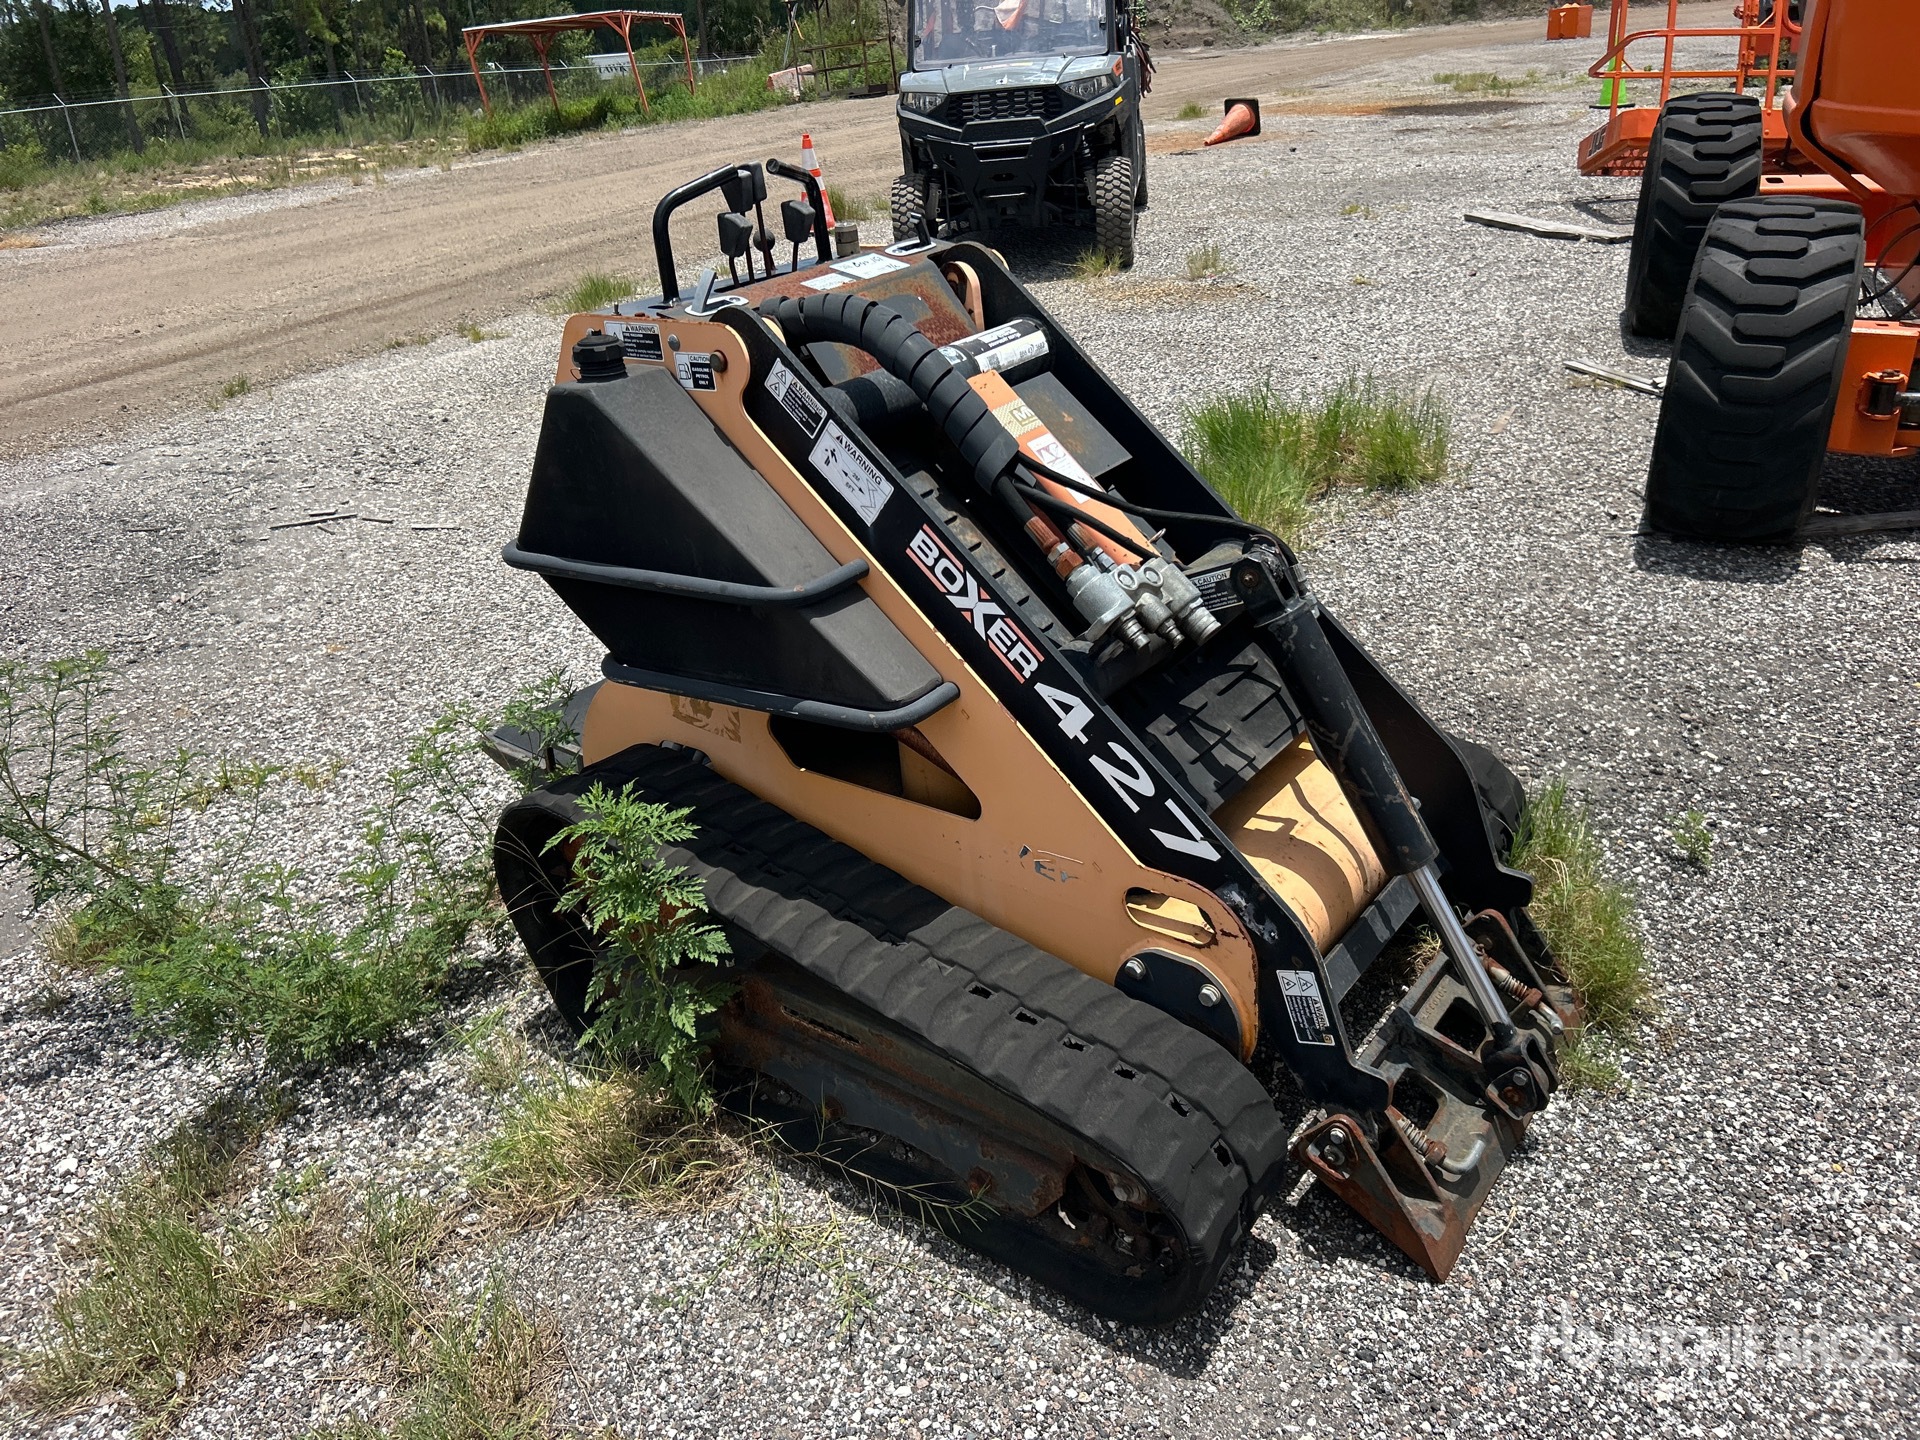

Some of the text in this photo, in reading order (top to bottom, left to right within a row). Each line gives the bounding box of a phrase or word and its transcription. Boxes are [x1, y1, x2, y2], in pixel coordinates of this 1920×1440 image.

[798, 385, 822, 414] WARNING
[844, 441, 881, 486] WARNING
[1198, 572, 1227, 585] CAUTION
[909, 529, 1039, 680] BOXER
[1034, 682, 1222, 862] 427
